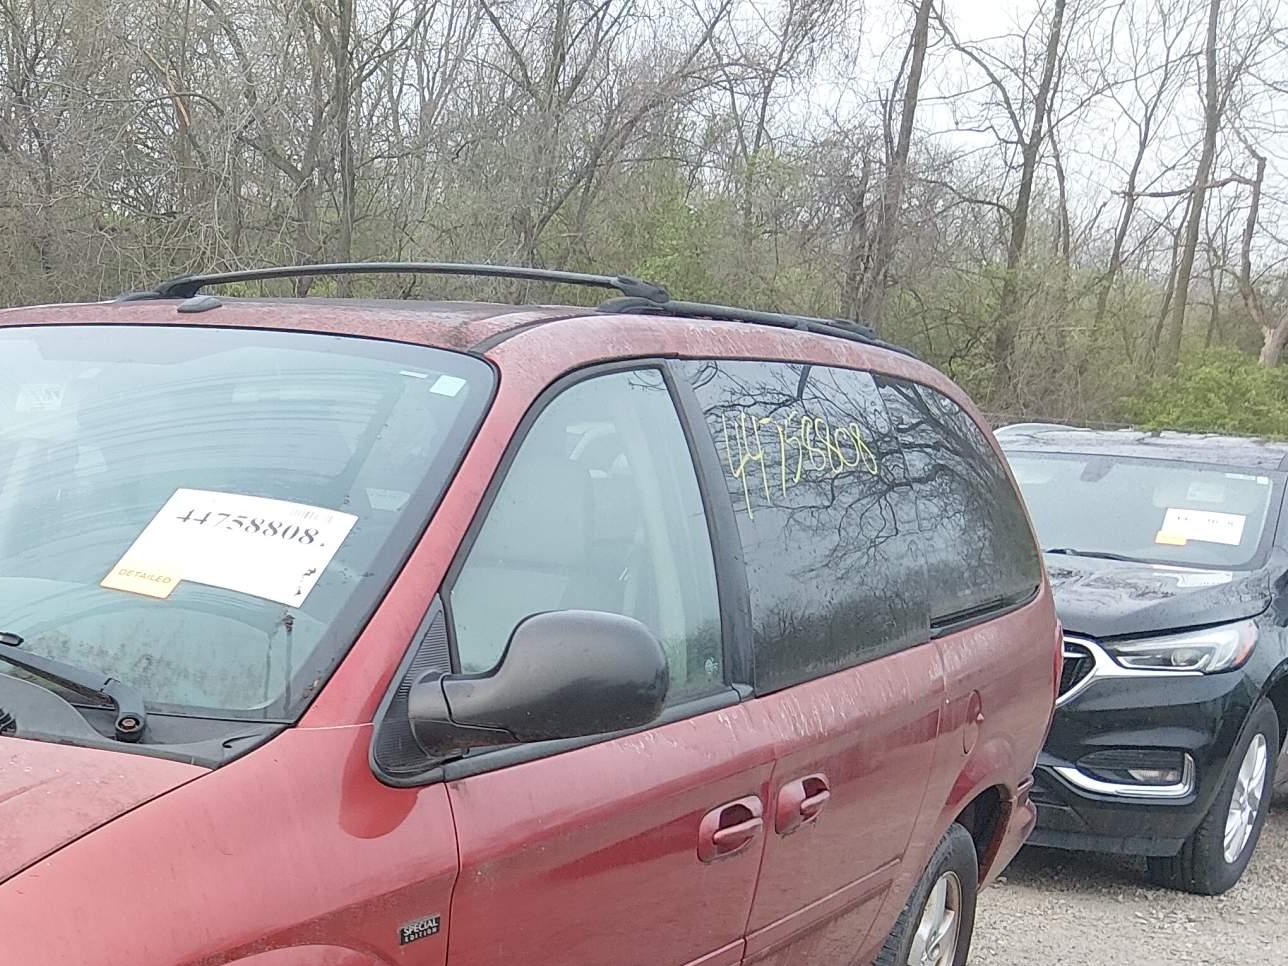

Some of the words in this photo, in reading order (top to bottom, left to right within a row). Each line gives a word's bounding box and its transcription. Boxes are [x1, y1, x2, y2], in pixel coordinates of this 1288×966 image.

[721, 410, 880, 521] 44758808
[118, 568, 172, 584] DETAILED
[404, 919, 439, 936] SPECIAL
[404, 928, 437, 942] EDITION
